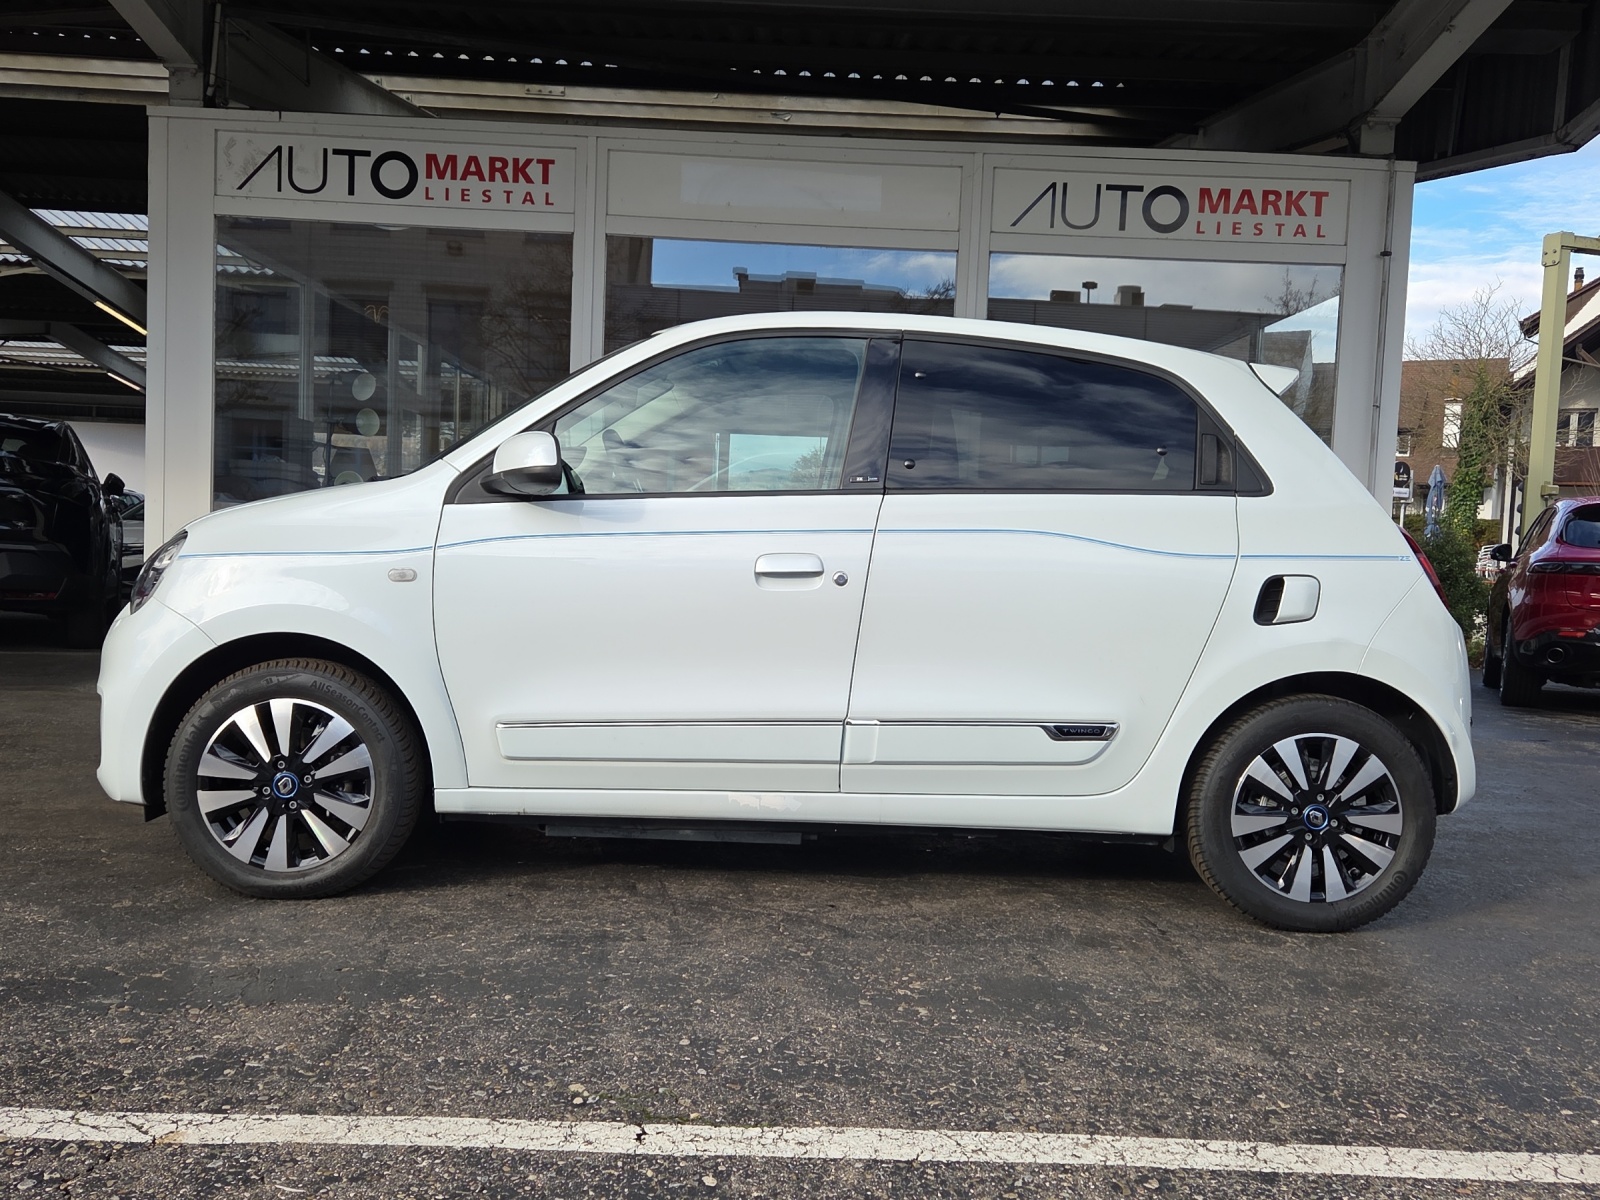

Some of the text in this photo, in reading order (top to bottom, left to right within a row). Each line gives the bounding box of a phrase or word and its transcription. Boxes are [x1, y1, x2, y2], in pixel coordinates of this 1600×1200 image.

[236, 145, 556, 200] AUTO MARKT
[424, 186, 555, 206] LIESTAL
[1010, 182, 1330, 234] AUTO MARKT
[1195, 221, 1327, 238] LIESTAL
[309, 680, 386, 744] AllSeasonContact
[174, 724, 201, 811] Continental
